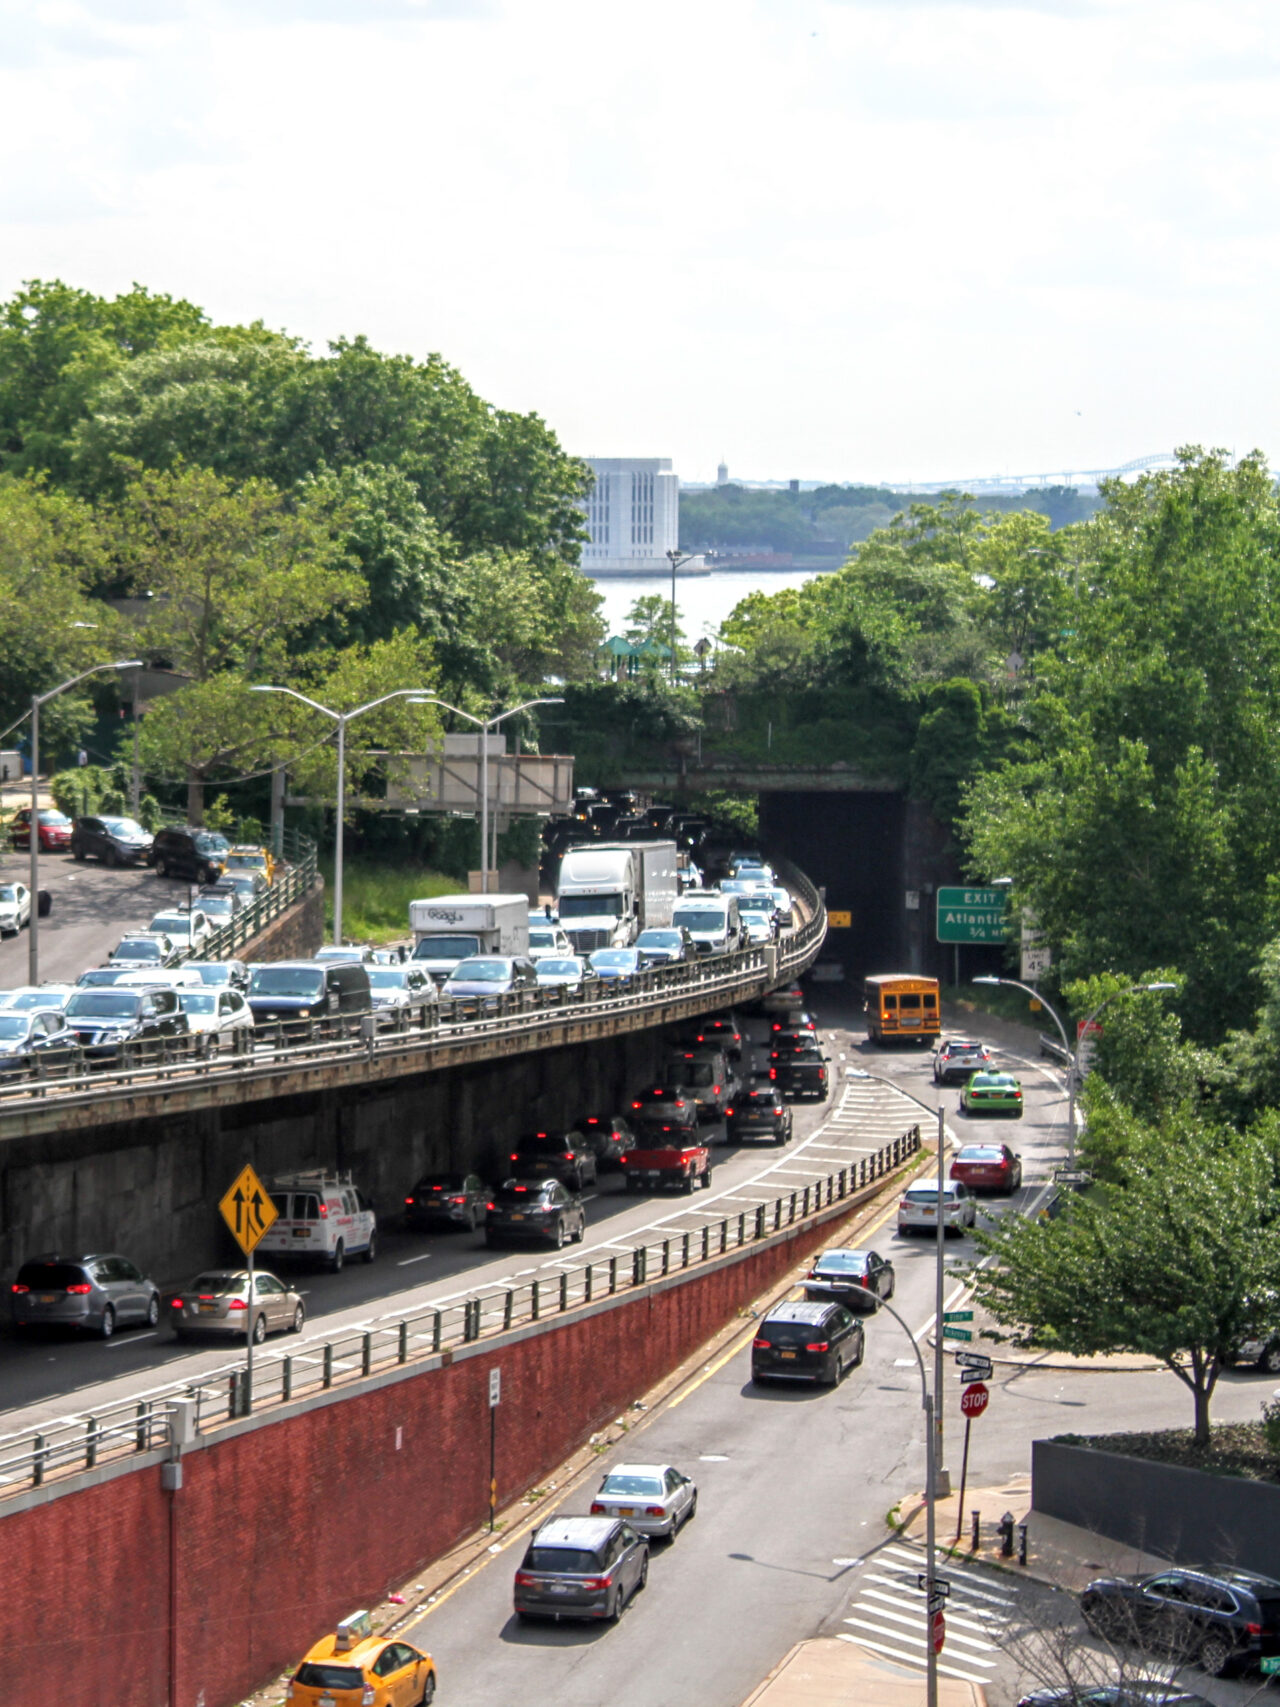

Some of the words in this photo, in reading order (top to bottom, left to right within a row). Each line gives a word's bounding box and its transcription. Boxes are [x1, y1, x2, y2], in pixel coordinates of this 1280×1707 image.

[964, 893, 996, 904] EXIT
[945, 912, 1006, 925] Atlantic
[1028, 960, 1045, 972] 45
[962, 1392, 988, 1409] STOP
